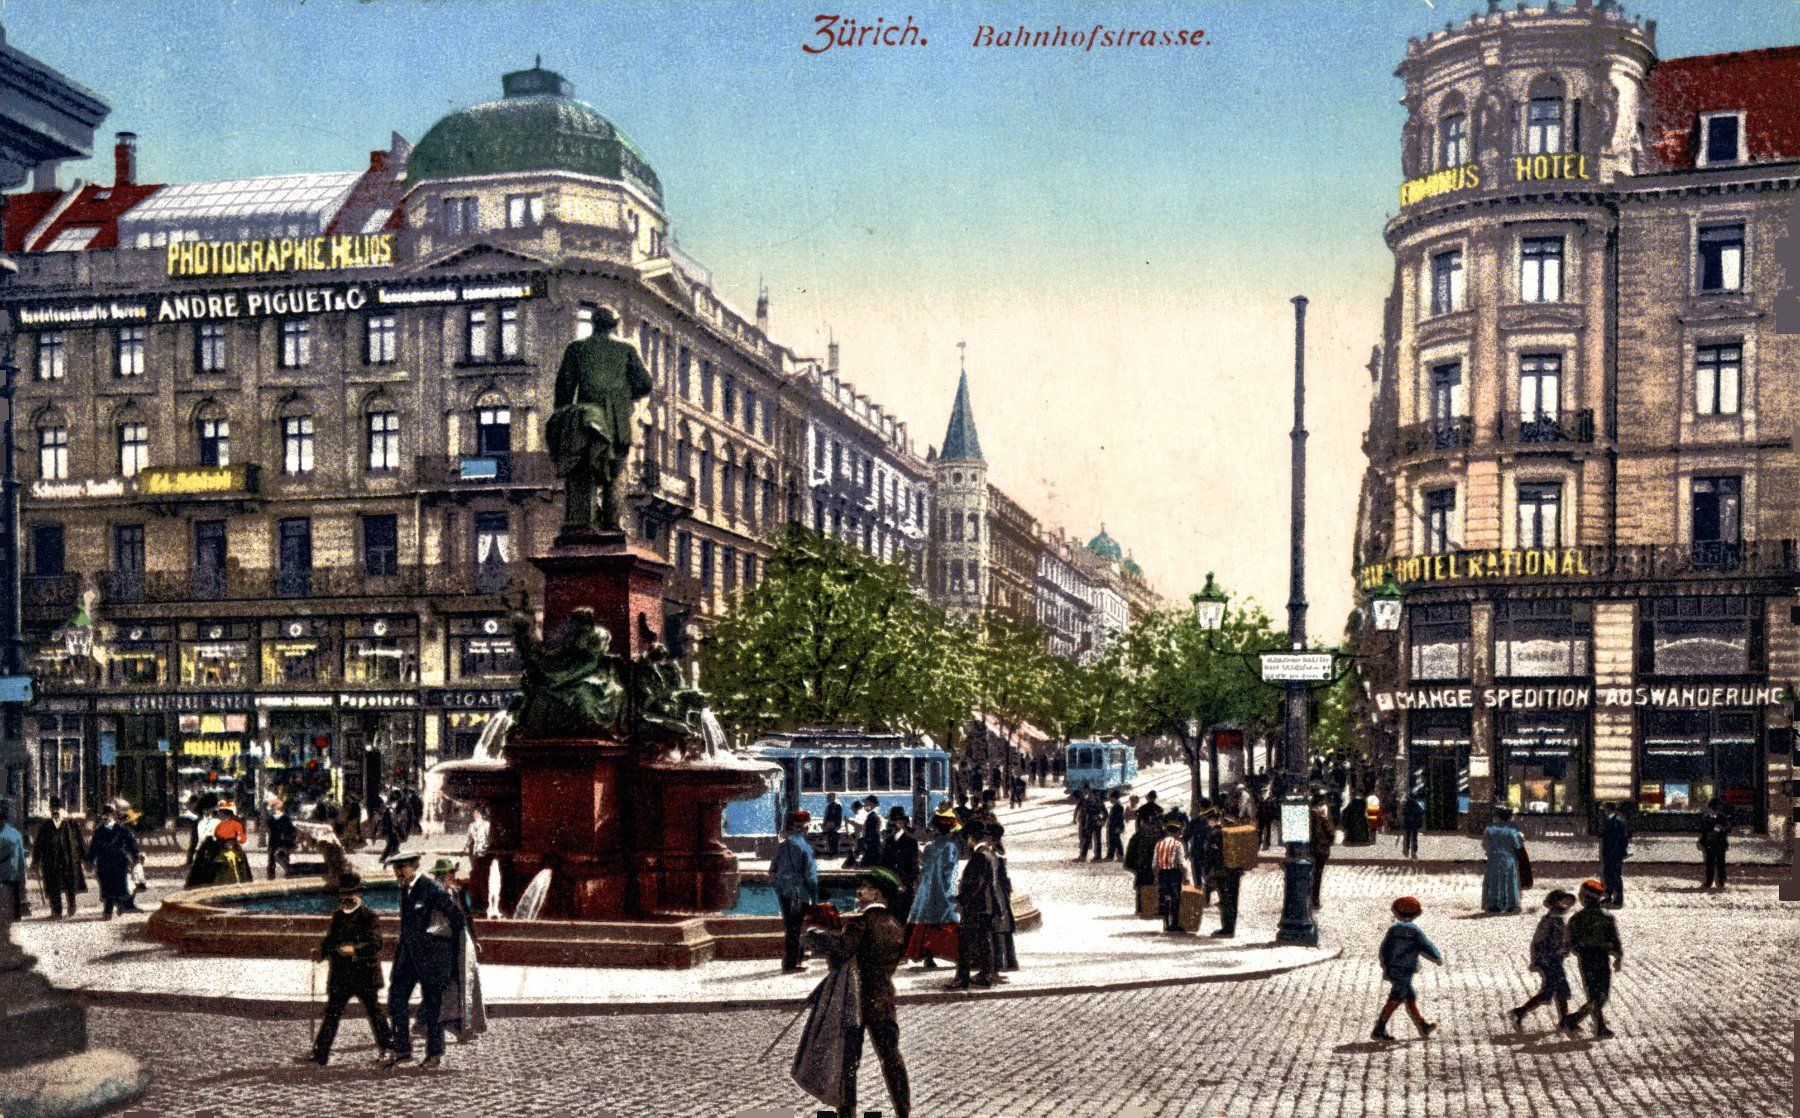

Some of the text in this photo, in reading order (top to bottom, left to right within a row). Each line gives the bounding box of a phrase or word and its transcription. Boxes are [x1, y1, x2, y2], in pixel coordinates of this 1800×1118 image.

[1516, 154, 1590, 182] HOTEL
[167, 233, 393, 276] PHOTOGRAPHIE HELIOS
[158, 294, 239, 322] ANDRE
[1397, 553, 1461, 583] HOTEL
[1484, 687, 1589, 709] SPEDITION
